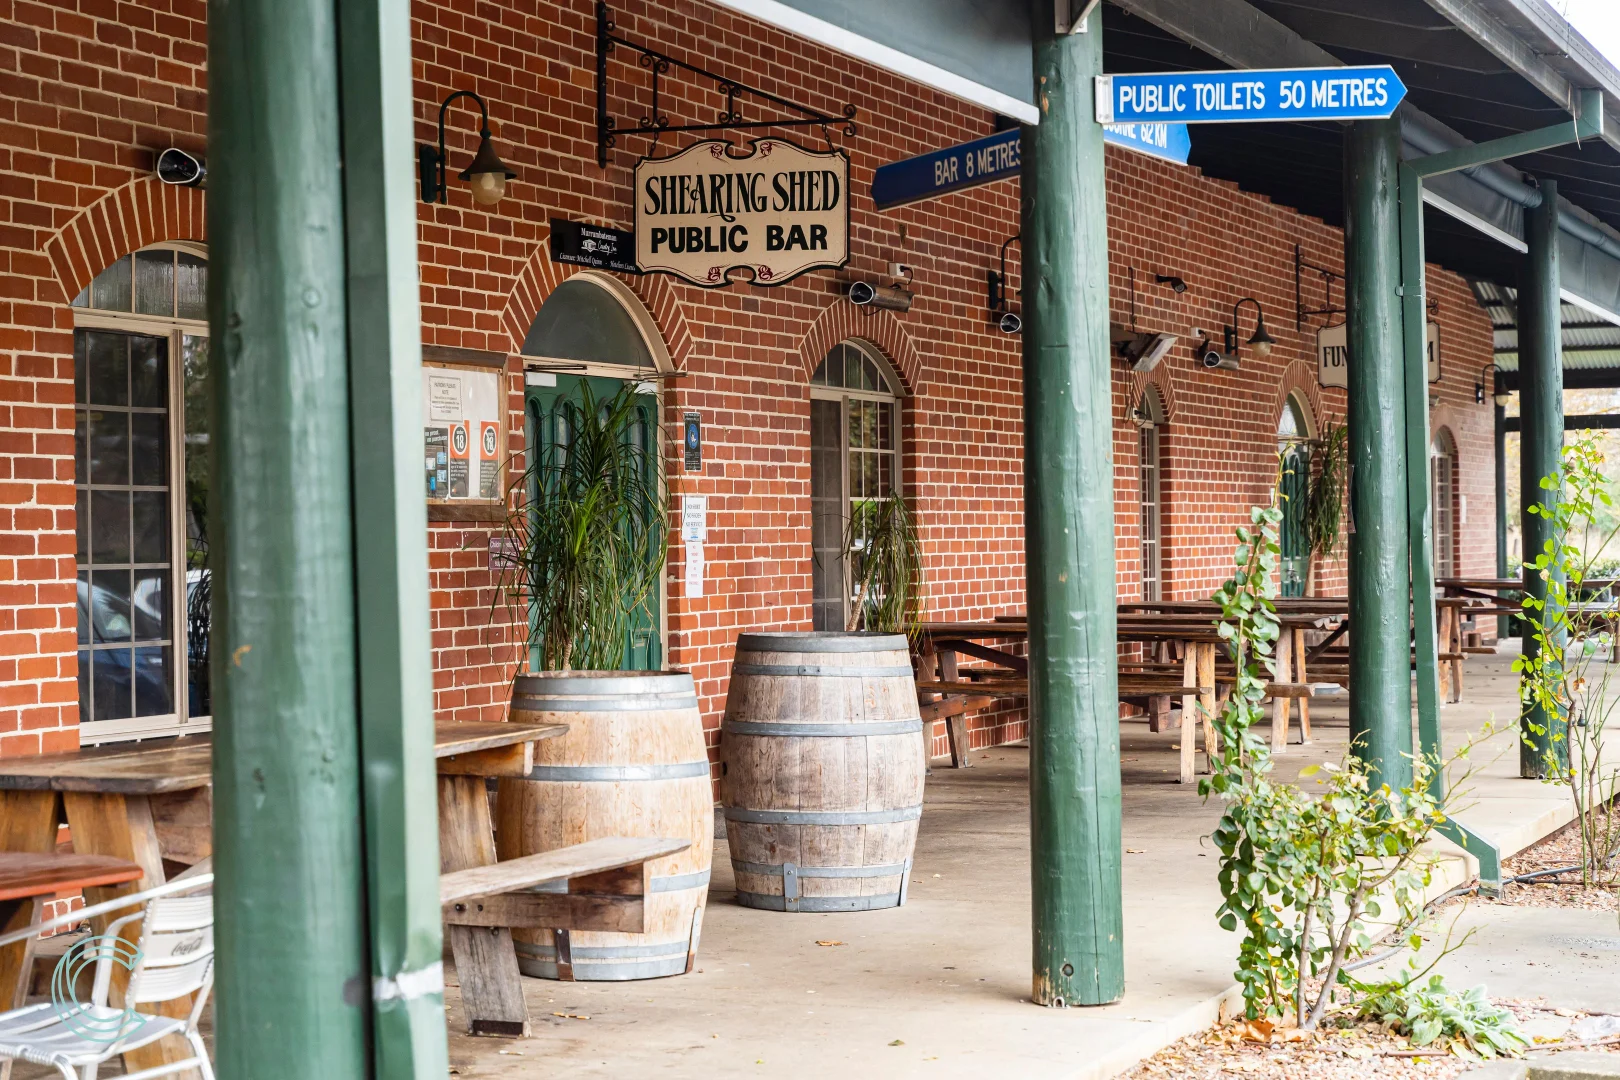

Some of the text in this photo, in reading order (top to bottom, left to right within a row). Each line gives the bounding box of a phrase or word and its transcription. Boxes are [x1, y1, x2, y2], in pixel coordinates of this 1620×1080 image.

[1119, 77, 1388, 113] PUBLIC TOILETS 50 METRES
[1154, 123, 1168, 149] KM
[934, 156, 959, 186] BAR
[966, 152, 974, 178] 8
[644, 169, 840, 223] SHEARING SHED
[650, 224, 828, 254] PUBLIC BAR
[456, 434, 464, 449] 18
